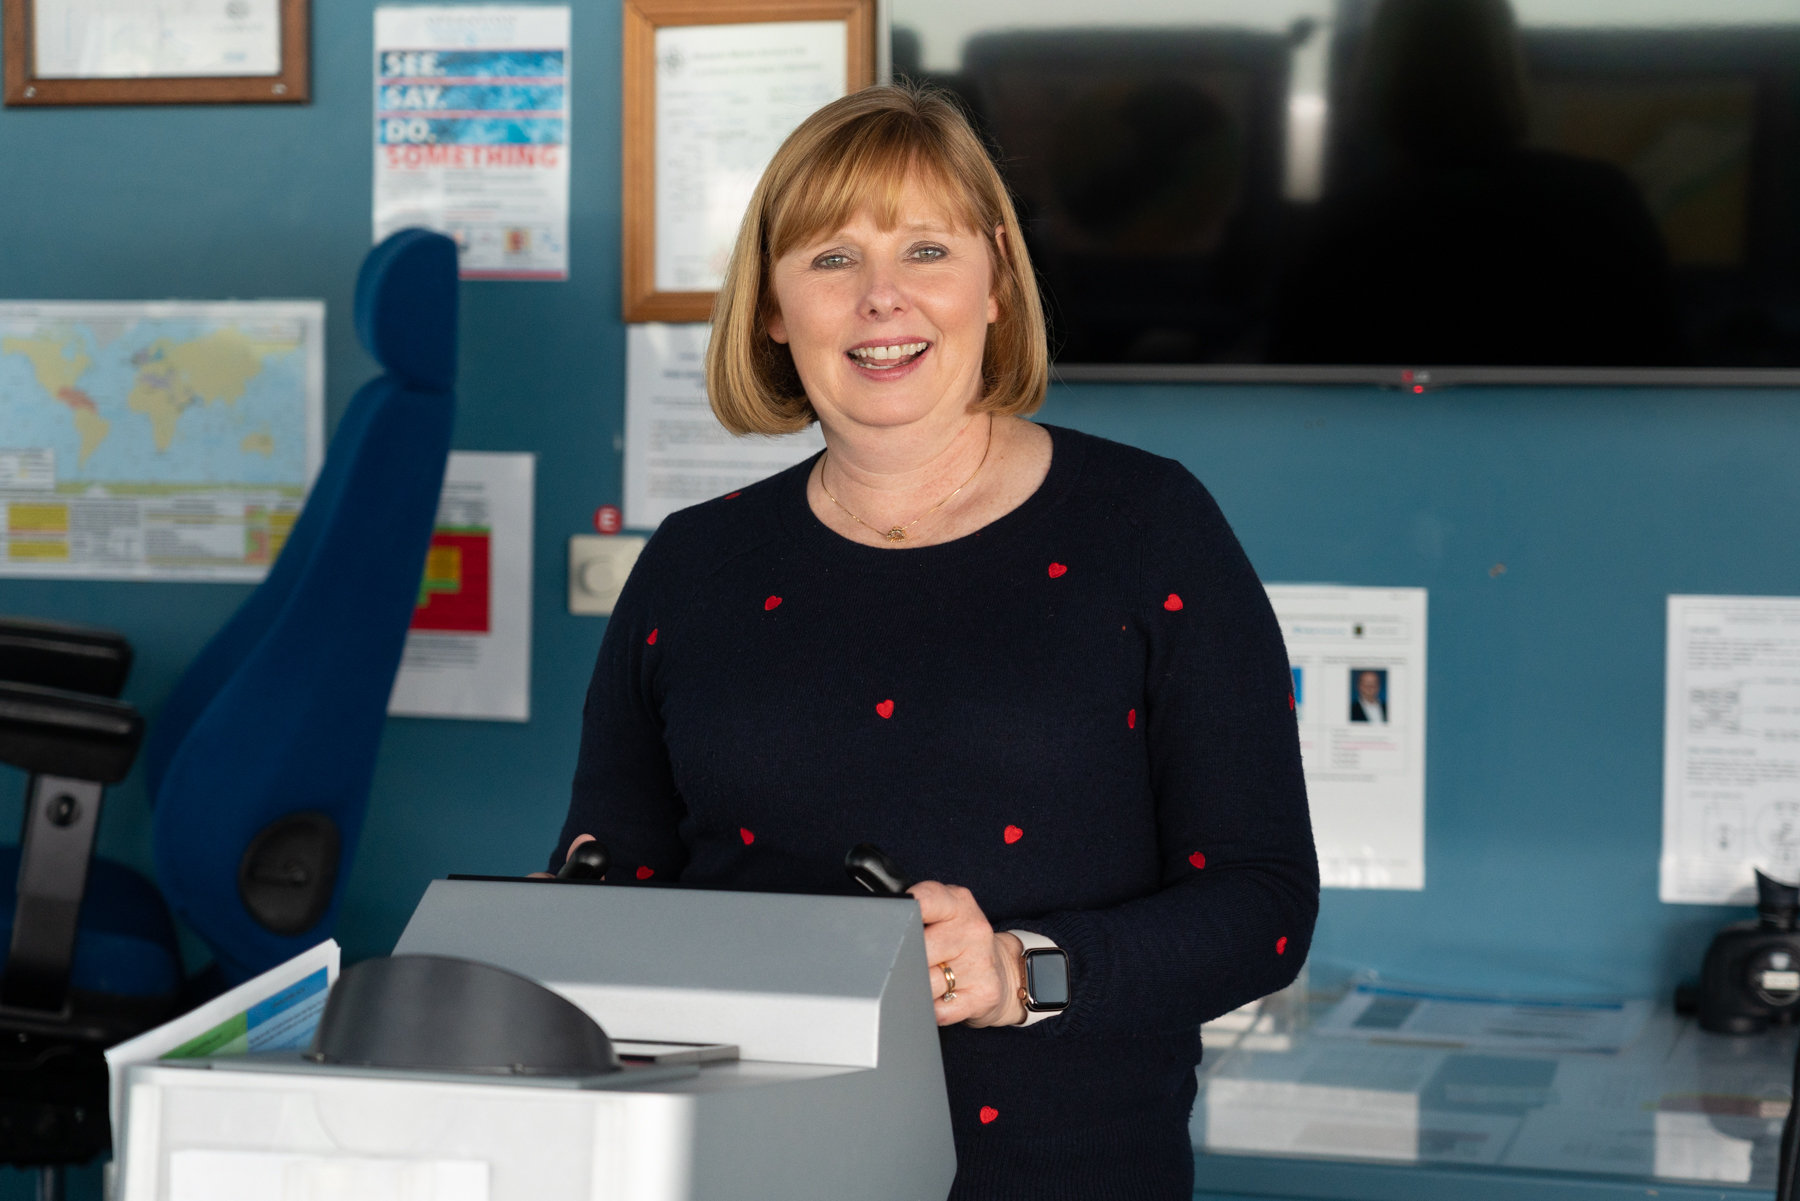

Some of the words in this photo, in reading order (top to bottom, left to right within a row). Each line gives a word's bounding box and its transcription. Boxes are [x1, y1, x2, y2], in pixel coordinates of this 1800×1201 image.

[385, 52, 447, 77] SEE.
[385, 86, 448, 110] SAY.
[386, 118, 437, 143] DO.
[386, 145, 559, 169] SOMETHING
